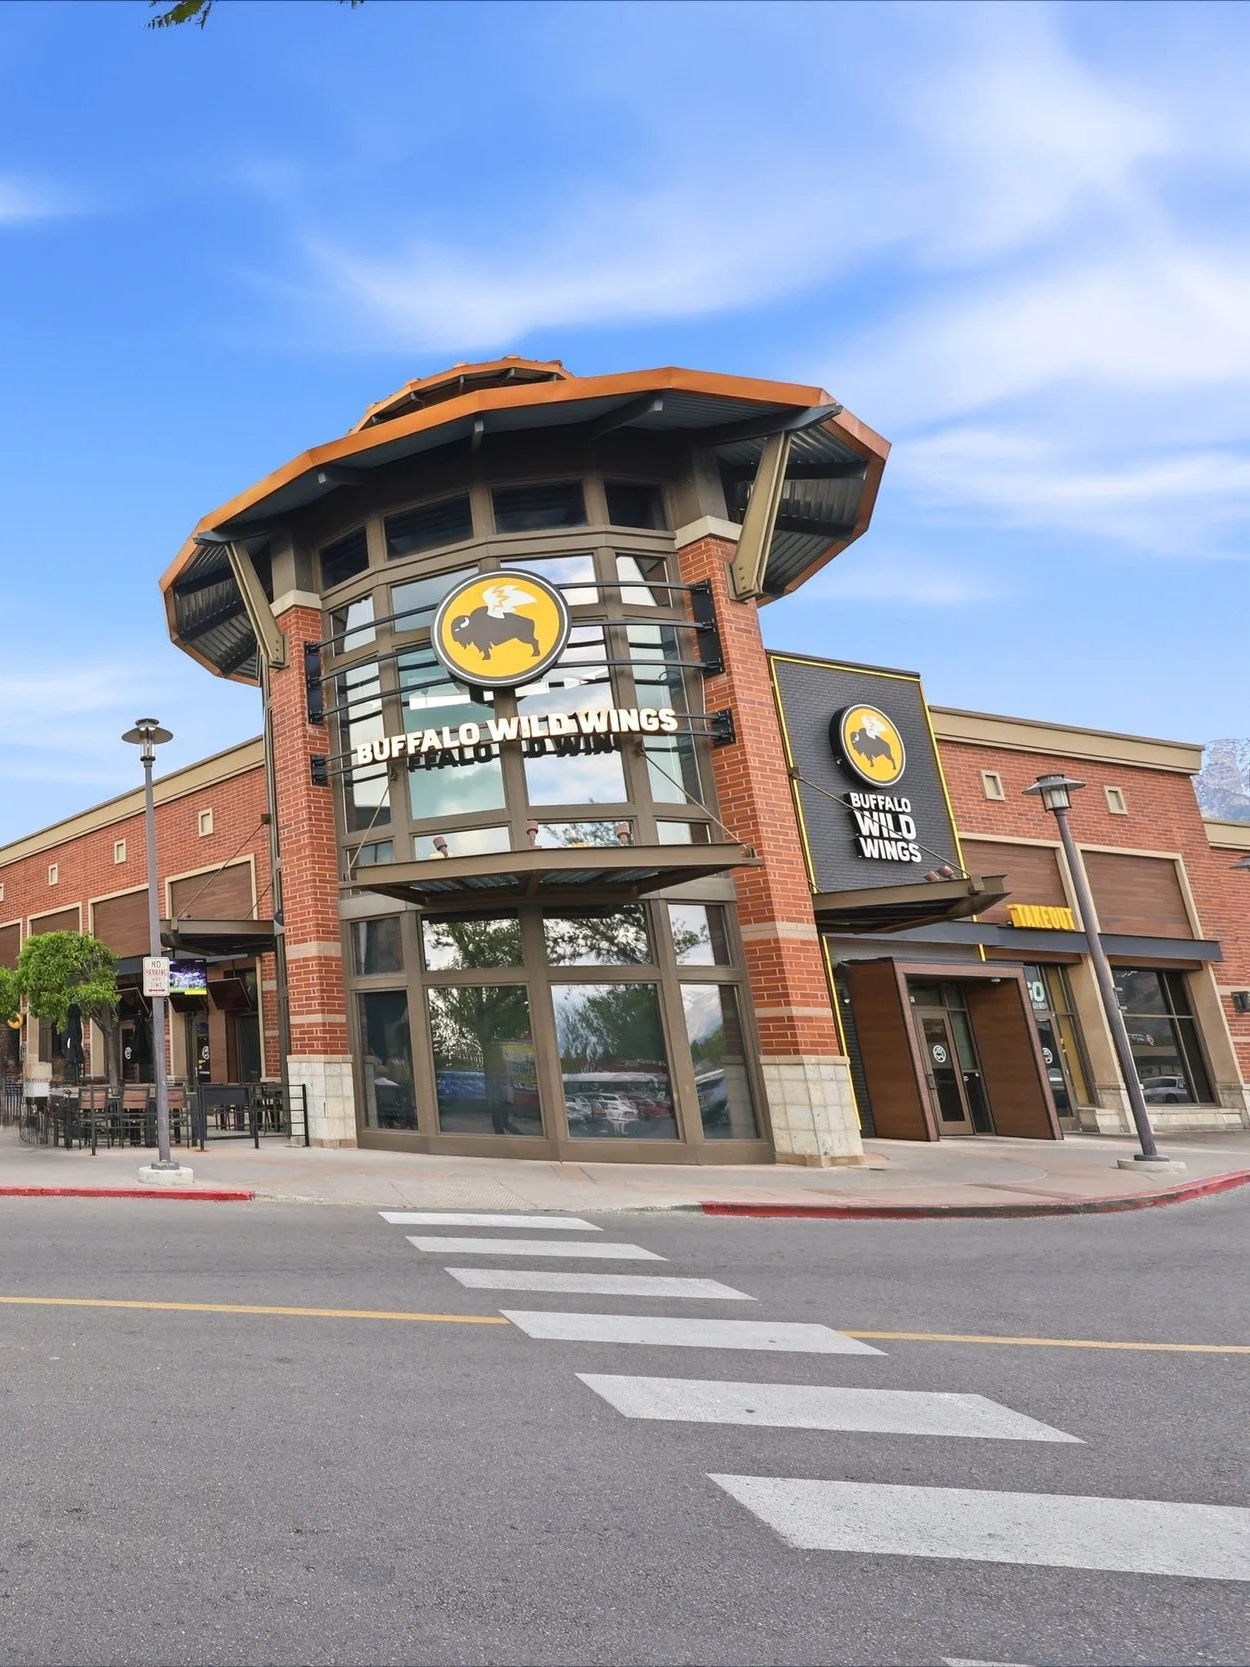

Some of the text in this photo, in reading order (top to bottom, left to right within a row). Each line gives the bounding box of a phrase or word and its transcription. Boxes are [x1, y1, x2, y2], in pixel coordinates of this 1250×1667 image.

[356, 708, 678, 765] BUFFALO WILD WINGS
[850, 792, 912, 813] BUFFALO
[854, 810, 917, 840] WILD
[859, 837, 922, 863] WINGS
[1013, 904, 1076, 930] TAKEOUT
